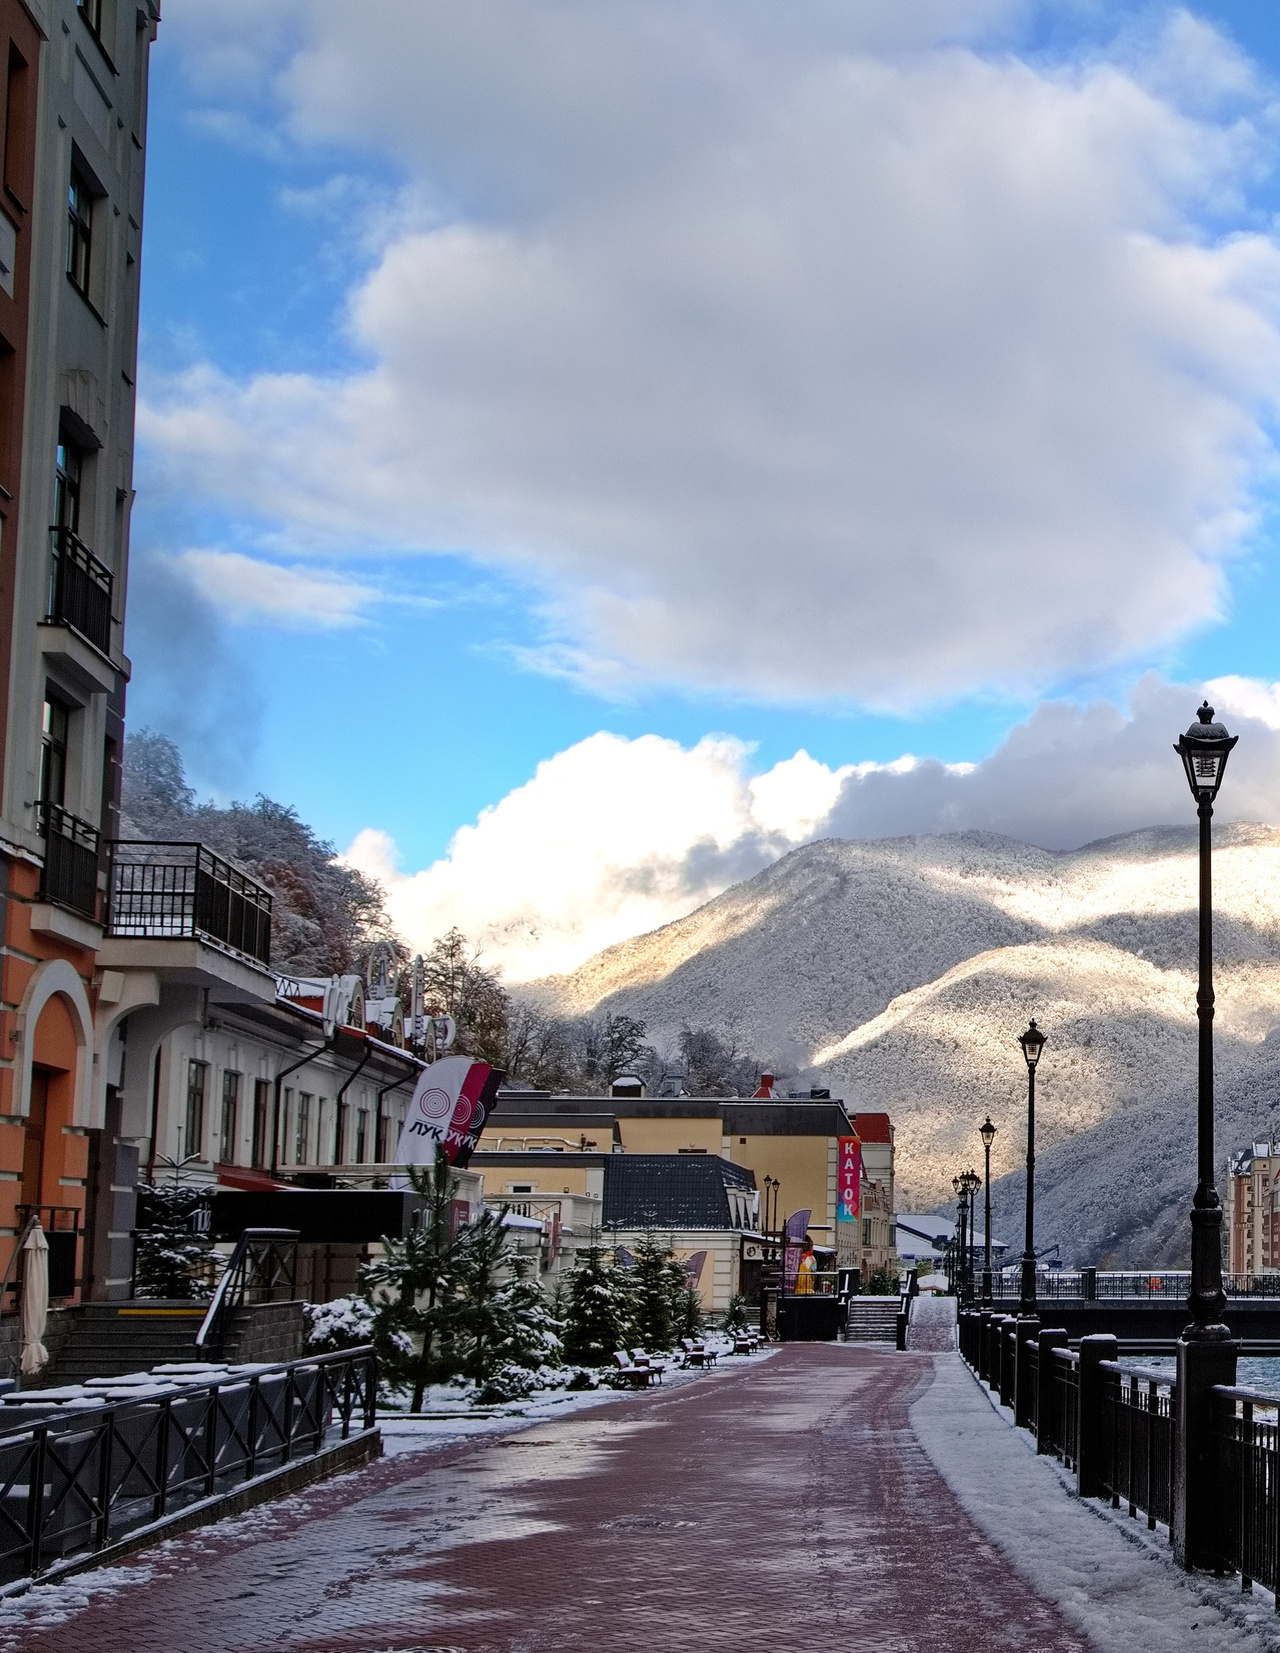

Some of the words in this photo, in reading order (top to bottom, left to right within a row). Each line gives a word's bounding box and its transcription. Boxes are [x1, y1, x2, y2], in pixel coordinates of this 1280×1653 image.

[409, 1121, 443, 1141] ЛУК
[446, 1130, 464, 1147] УК
[843, 1142, 854, 1216] КАТОК
